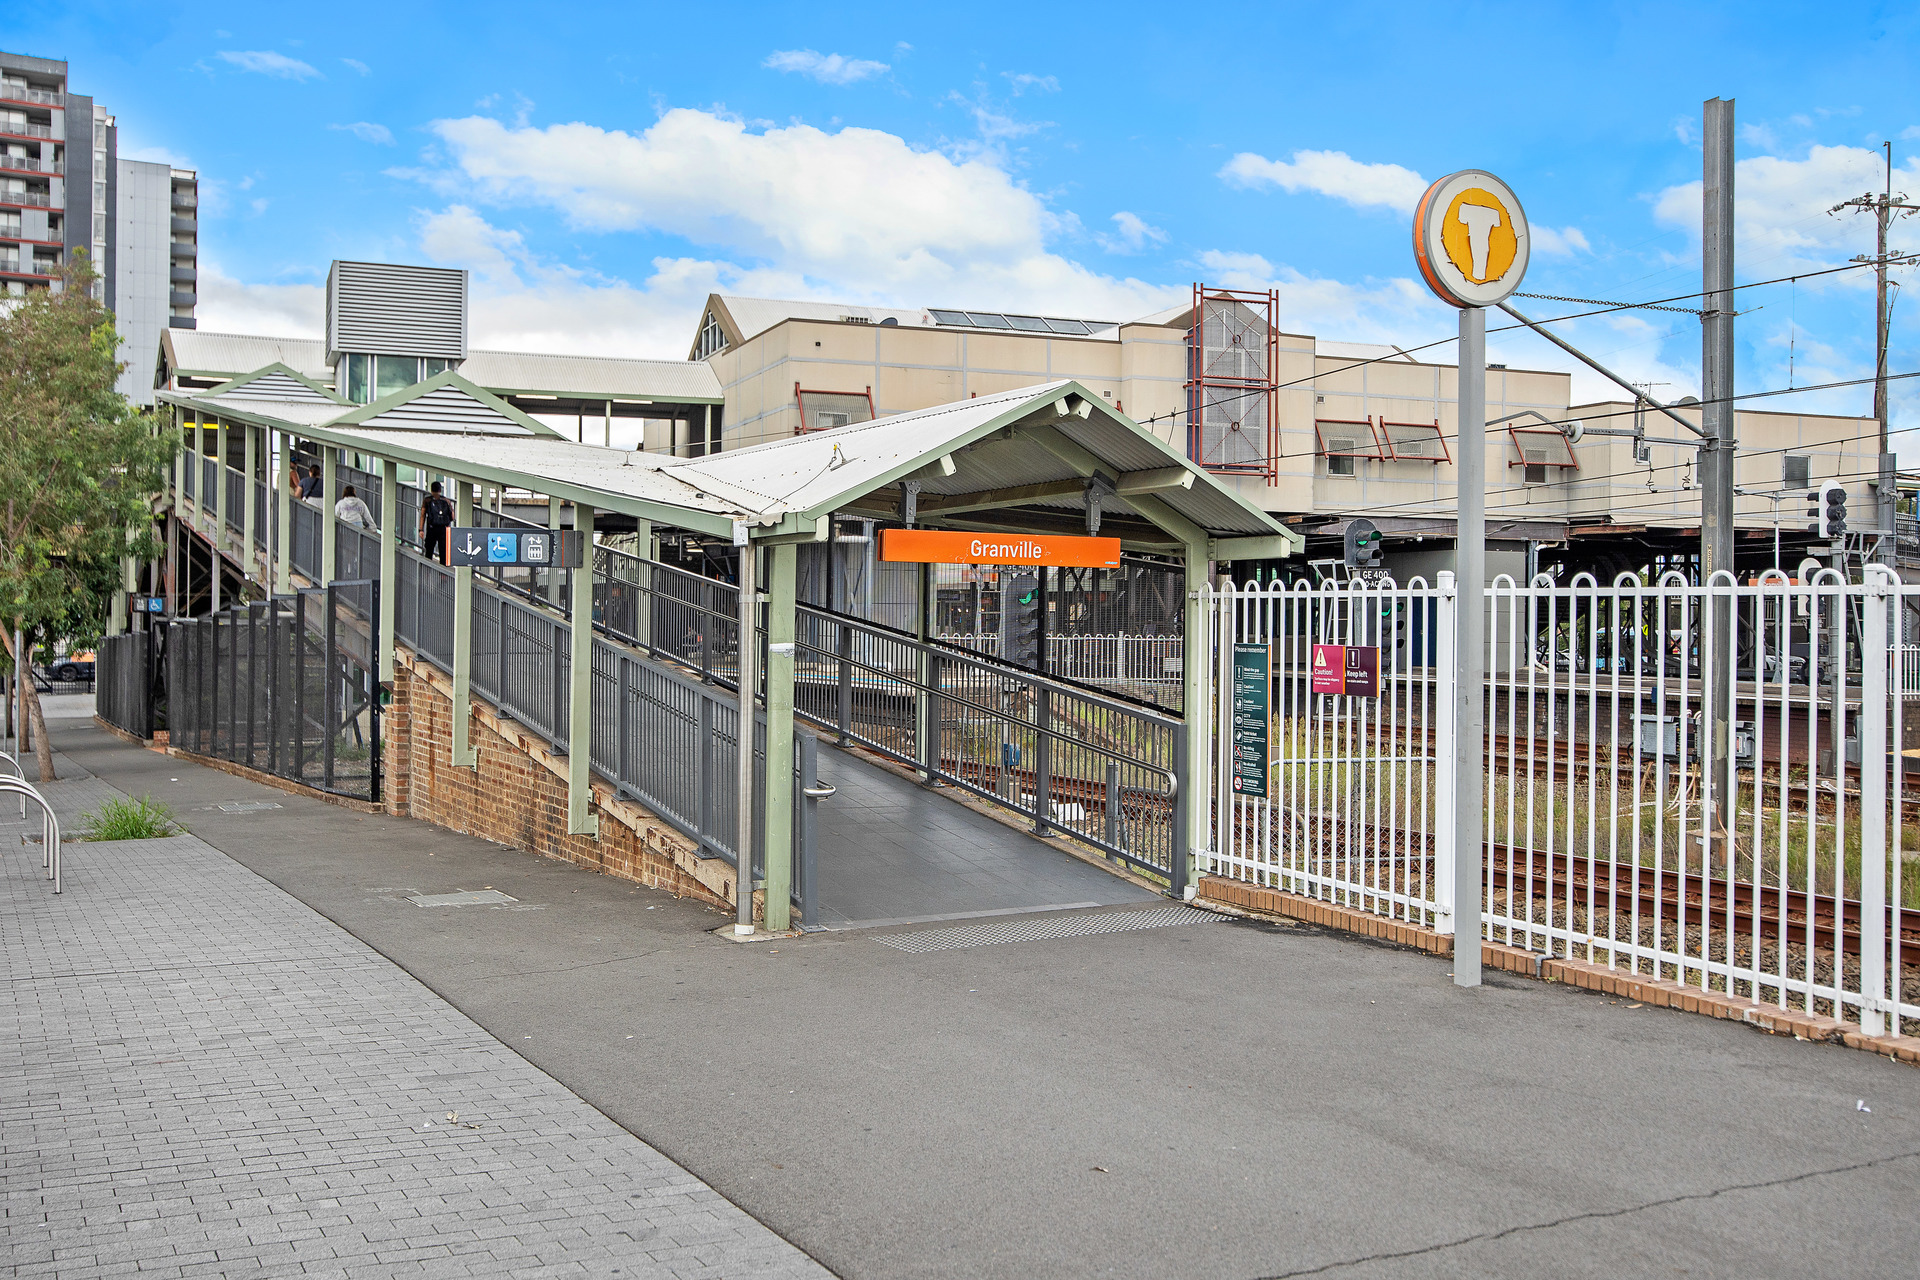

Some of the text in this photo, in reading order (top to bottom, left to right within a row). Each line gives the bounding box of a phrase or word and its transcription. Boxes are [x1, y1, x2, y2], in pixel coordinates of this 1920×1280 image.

[970, 540, 1042, 558] Granville
[1362, 570, 1388, 579] GE 400
[1347, 670, 1358, 678] Keep
